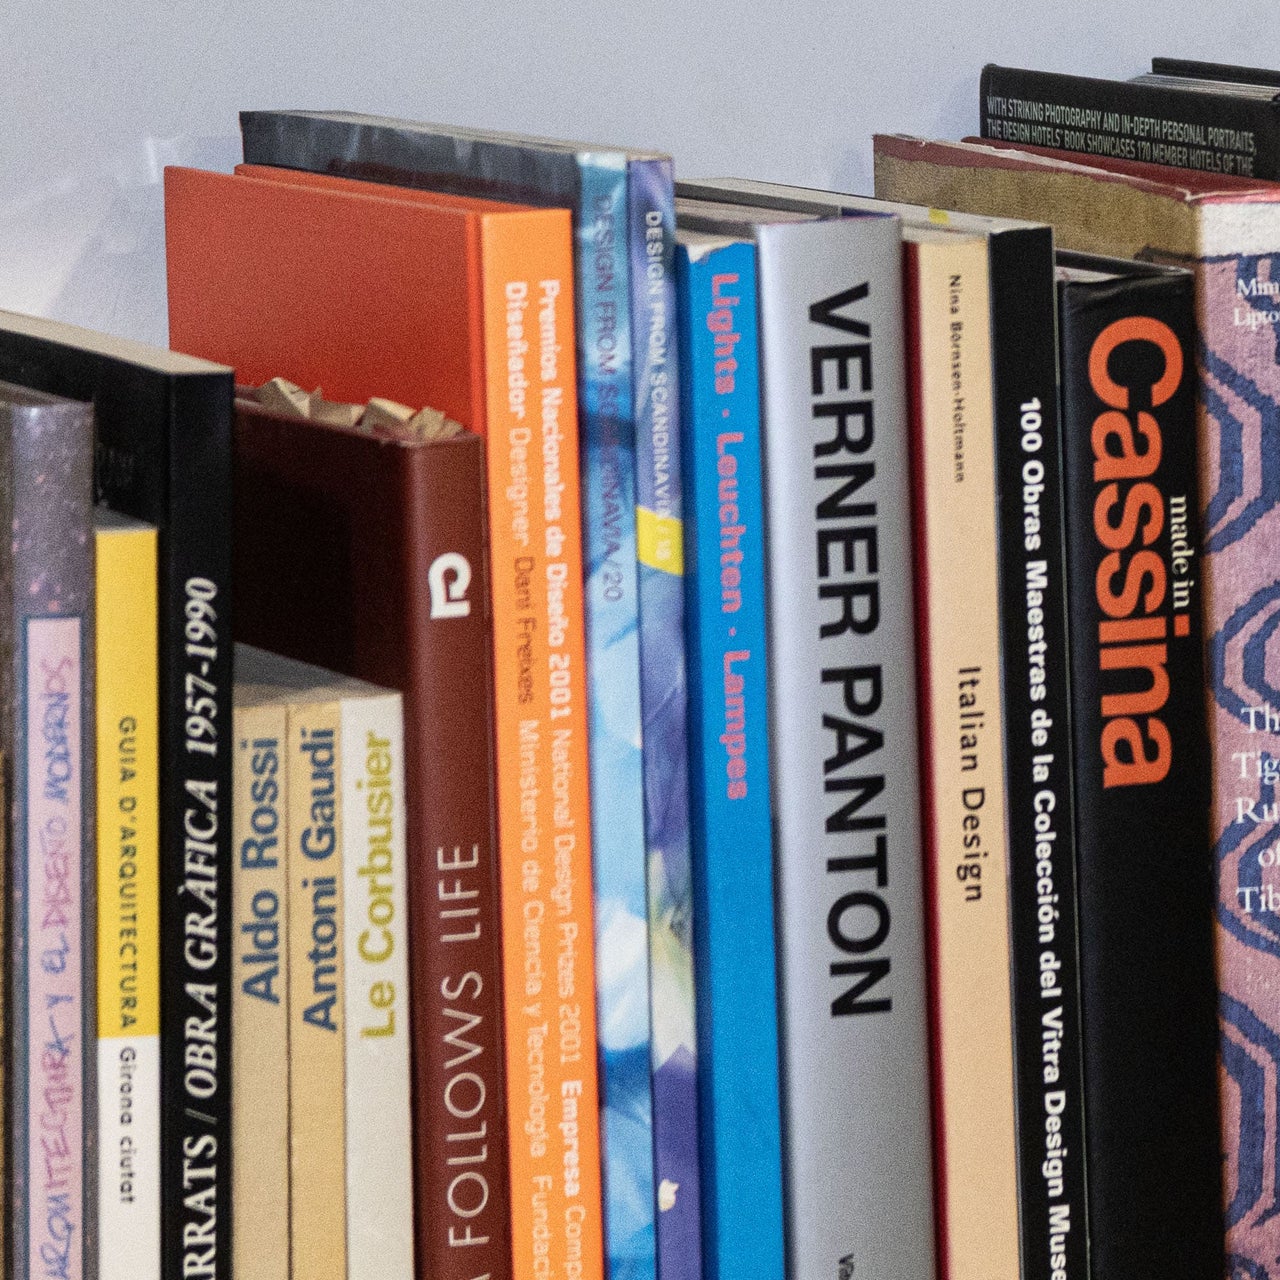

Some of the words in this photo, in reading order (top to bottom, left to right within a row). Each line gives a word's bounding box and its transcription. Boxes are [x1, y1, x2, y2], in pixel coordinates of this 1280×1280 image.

[987, 95, 1007, 114] WITH
[1008, 98, 1043, 121] STRIKING
[1045, 103, 1101, 130] PHOTOGRAPHY
[1103, 112, 1120, 133] AND
[1121, 114, 1160, 137] IN-DEPTH
[1162, 120, 1206, 145] PERSONAL
[987, 119, 1001, 138] THE
[1003, 121, 1030, 142] DESIGN
[1065, 131, 1086, 151] BOOK
[1087, 133, 1135, 157] SHOWCASES
[1152, 144, 1188, 166] MEMBER
[1189, 149, 1222, 171] HOTELS
[1223, 154, 1235, 171] OF
[645, 211, 665, 295] DESIGN
[949, 275, 961, 314] Nina
[505, 281, 529, 419] Diseñador
[539, 280, 561, 381] Premios
[647, 302, 667, 366] FROM
[708, 274, 740, 394] Lights
[542, 387, 565, 521] Nacionales
[650, 373, 671, 518] SCANDINAVIA
[810, 282, 880, 639] VERNER
[1020, 397, 1042, 452] 100
[506, 427, 531, 547] Designer
[718, 433, 745, 612] Leuchten
[1022, 460, 1044, 551] Obras
[1169, 495, 1194, 574] made
[514, 556, 535, 610] Dani
[545, 526, 565, 557] de
[1088, 316, 1190, 788] Cassina
[546, 563, 568, 647] Diseño
[1026, 560, 1048, 701] Maestras
[1173, 580, 1194, 608] in
[185, 577, 217, 755] 1957-1990
[549, 654, 571, 720] 2001
[118, 716, 137, 783] GUIA
[720, 651, 749, 799] Lampes
[959, 667, 982, 771] Italian
[1031, 709, 1052, 746] de
[1033, 754, 1054, 782] la
[240, 739, 278, 869] Rossi
[300, 729, 336, 861] Gaudi
[519, 719, 542, 852] Ministerio
[551, 729, 575, 828] National
[178, 780, 217, 970] GRÀFICA
[356, 731, 395, 964] Corbusier
[522, 860, 542, 892] de
[550, 834, 575, 916] Design
[822, 665, 892, 1016] PANTON
[956, 787, 985, 902] Design
[1034, 790, 1059, 943] Colección
[119, 797, 138, 1029] D'ARQUITECTURA
[437, 845, 480, 942] LIFE
[241, 890, 279, 1004] Aldo
[302, 876, 337, 1033] Antoni
[523, 900, 545, 996] Ciencia
[557, 922, 578, 998] Prizes
[1039, 951, 1062, 998] del
[185, 983, 217, 1098] OBRA
[361, 981, 396, 1038] Le
[522, 1003, 541, 1017] y
[559, 1004, 581, 1065] 2001
[1042, 1006, 1063, 1083] Vitra
[119, 1047, 136, 1125] Girona
[440, 971, 489, 1247] FOLLOWS
[120, 1136, 135, 1204] ciutat
[559, 1080, 582, 1197] Empresa
[1042, 1090, 1067, 1197] Design
[183, 1135, 217, 1280] RRATS
